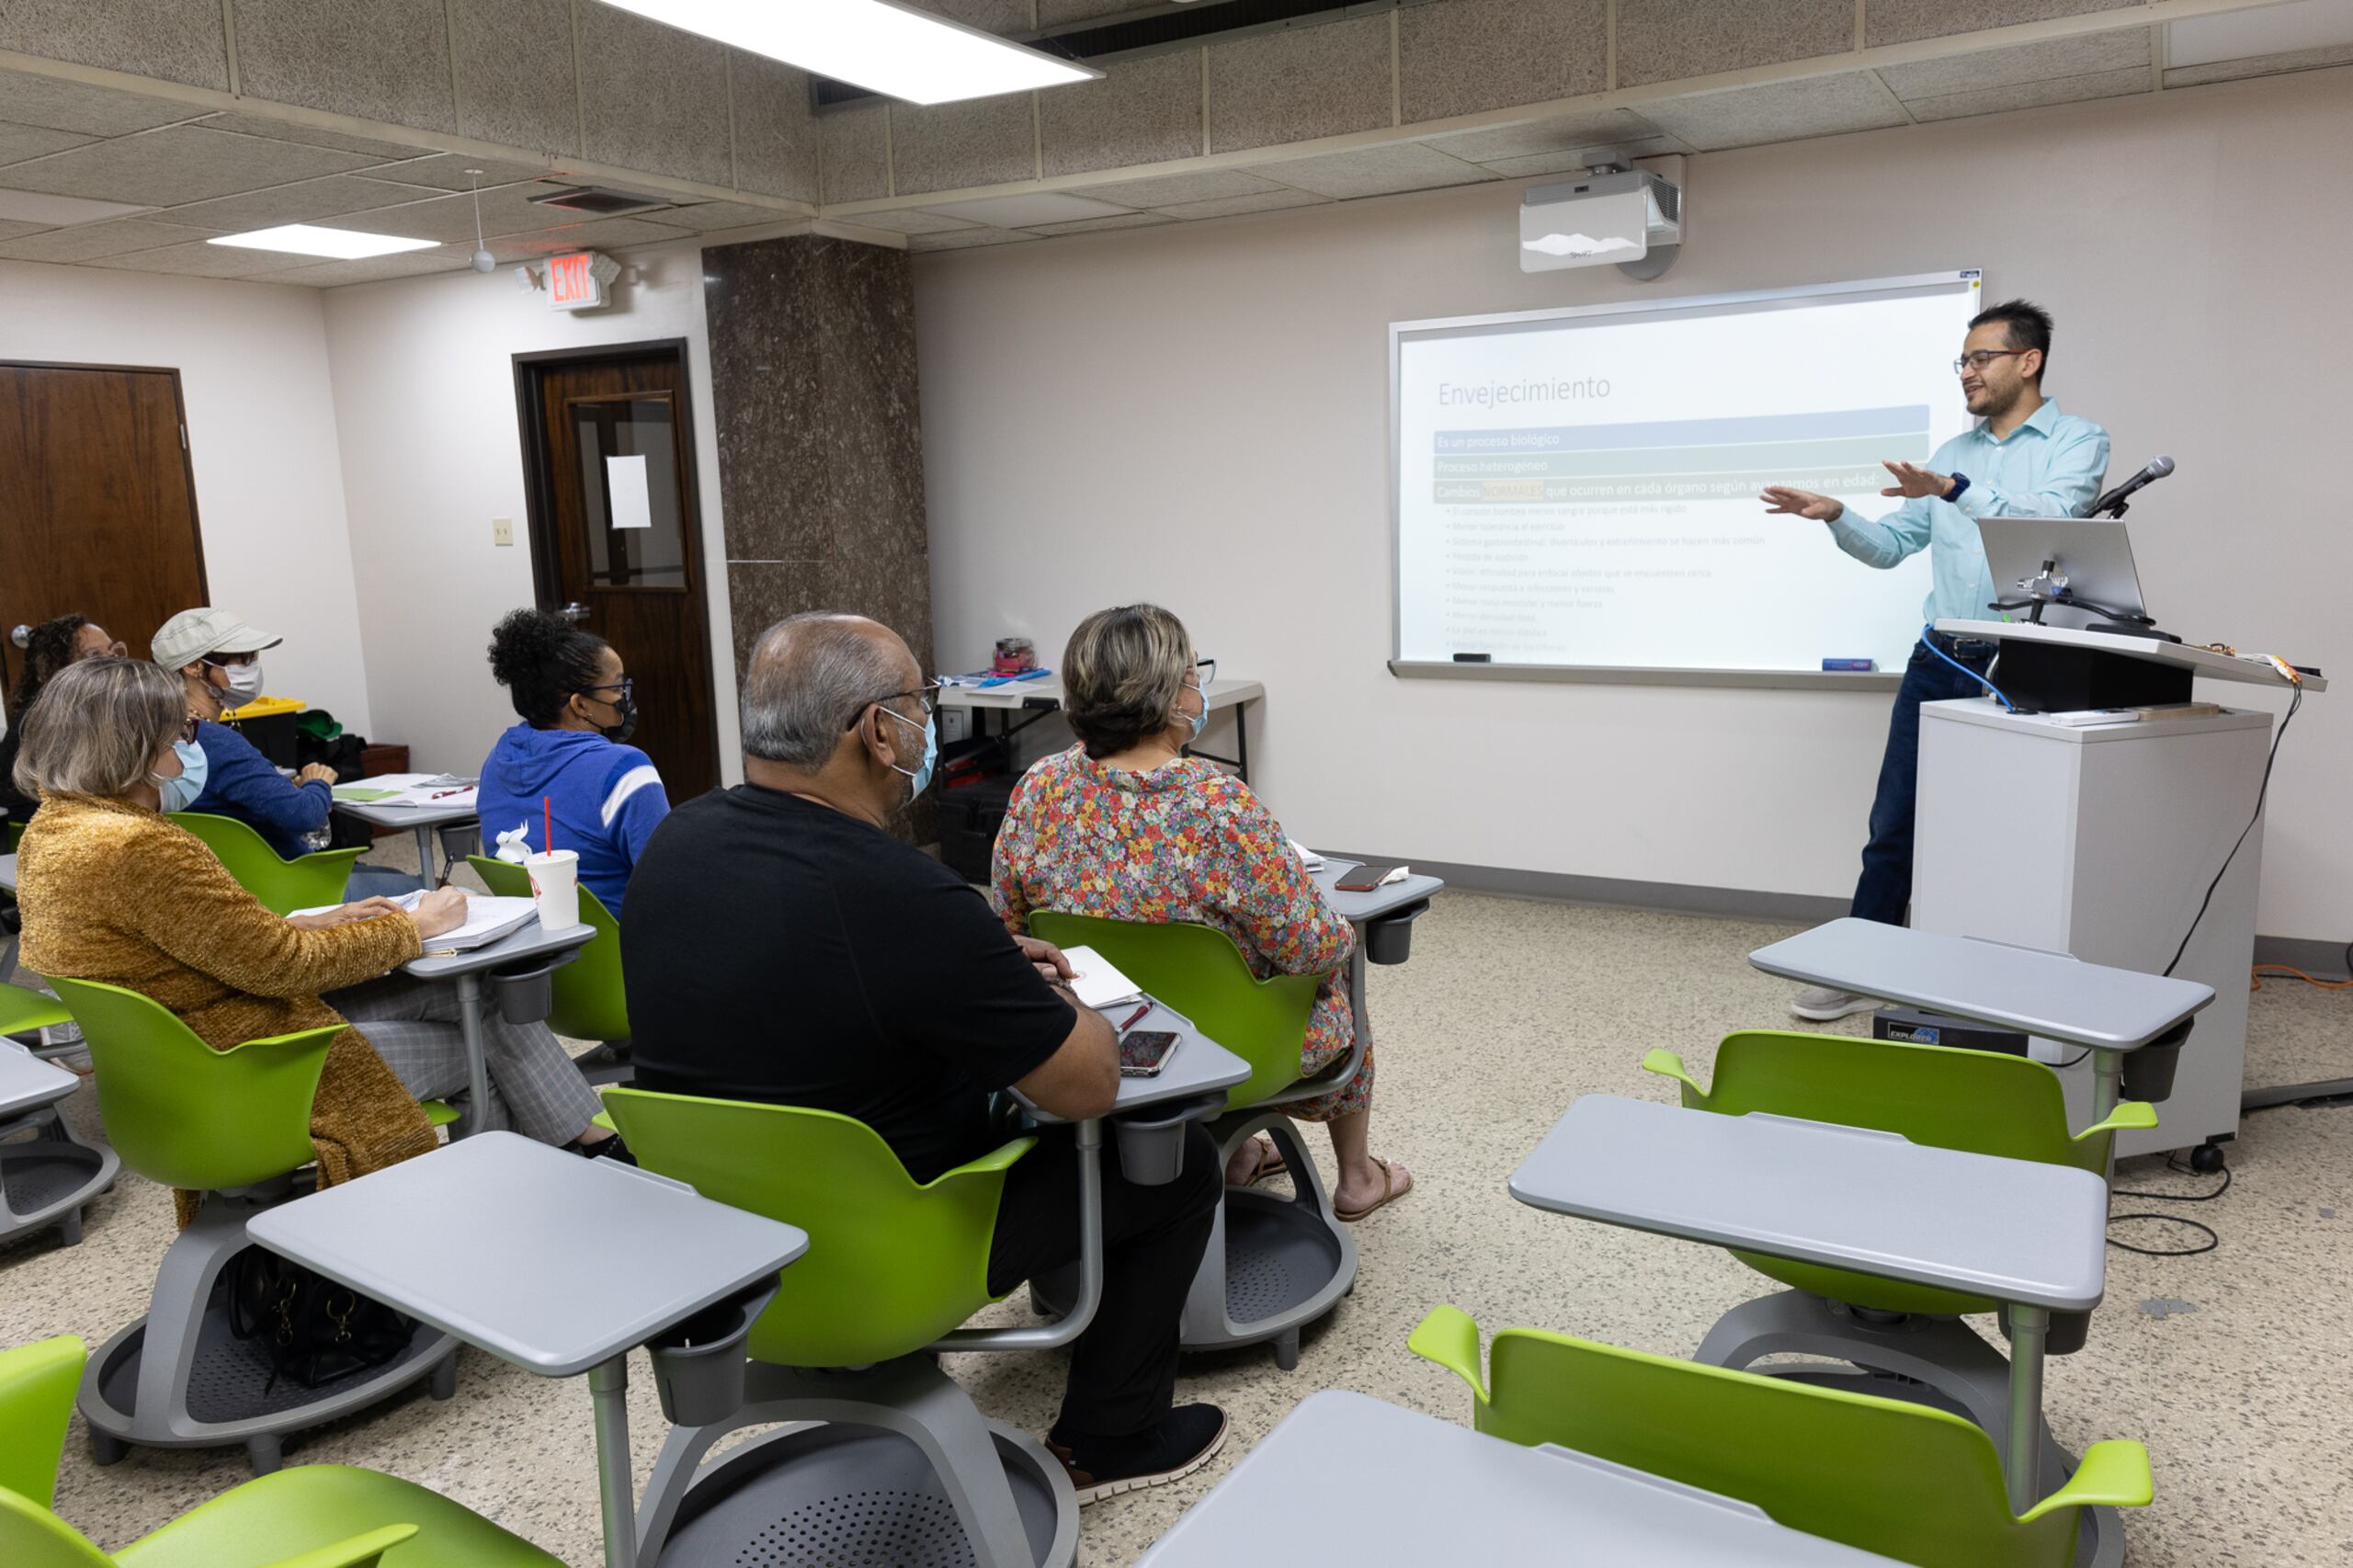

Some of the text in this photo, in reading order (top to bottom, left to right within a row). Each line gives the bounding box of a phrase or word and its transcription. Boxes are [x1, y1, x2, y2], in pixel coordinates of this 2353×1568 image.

[550, 254, 589, 301] EXIT
[1438, 376, 1610, 410] Envejecimiento
[1438, 432, 1560, 450] Es un proceso biológico
[1438, 460, 1548, 475] Proceso heterogéneo
[1438, 472, 1880, 499] Cambios NORMALES que ocurren en cada órgano según avanzamos en edad:
[1587, 506, 1618, 517] porque
[1682, 536, 1709, 545] hacen
